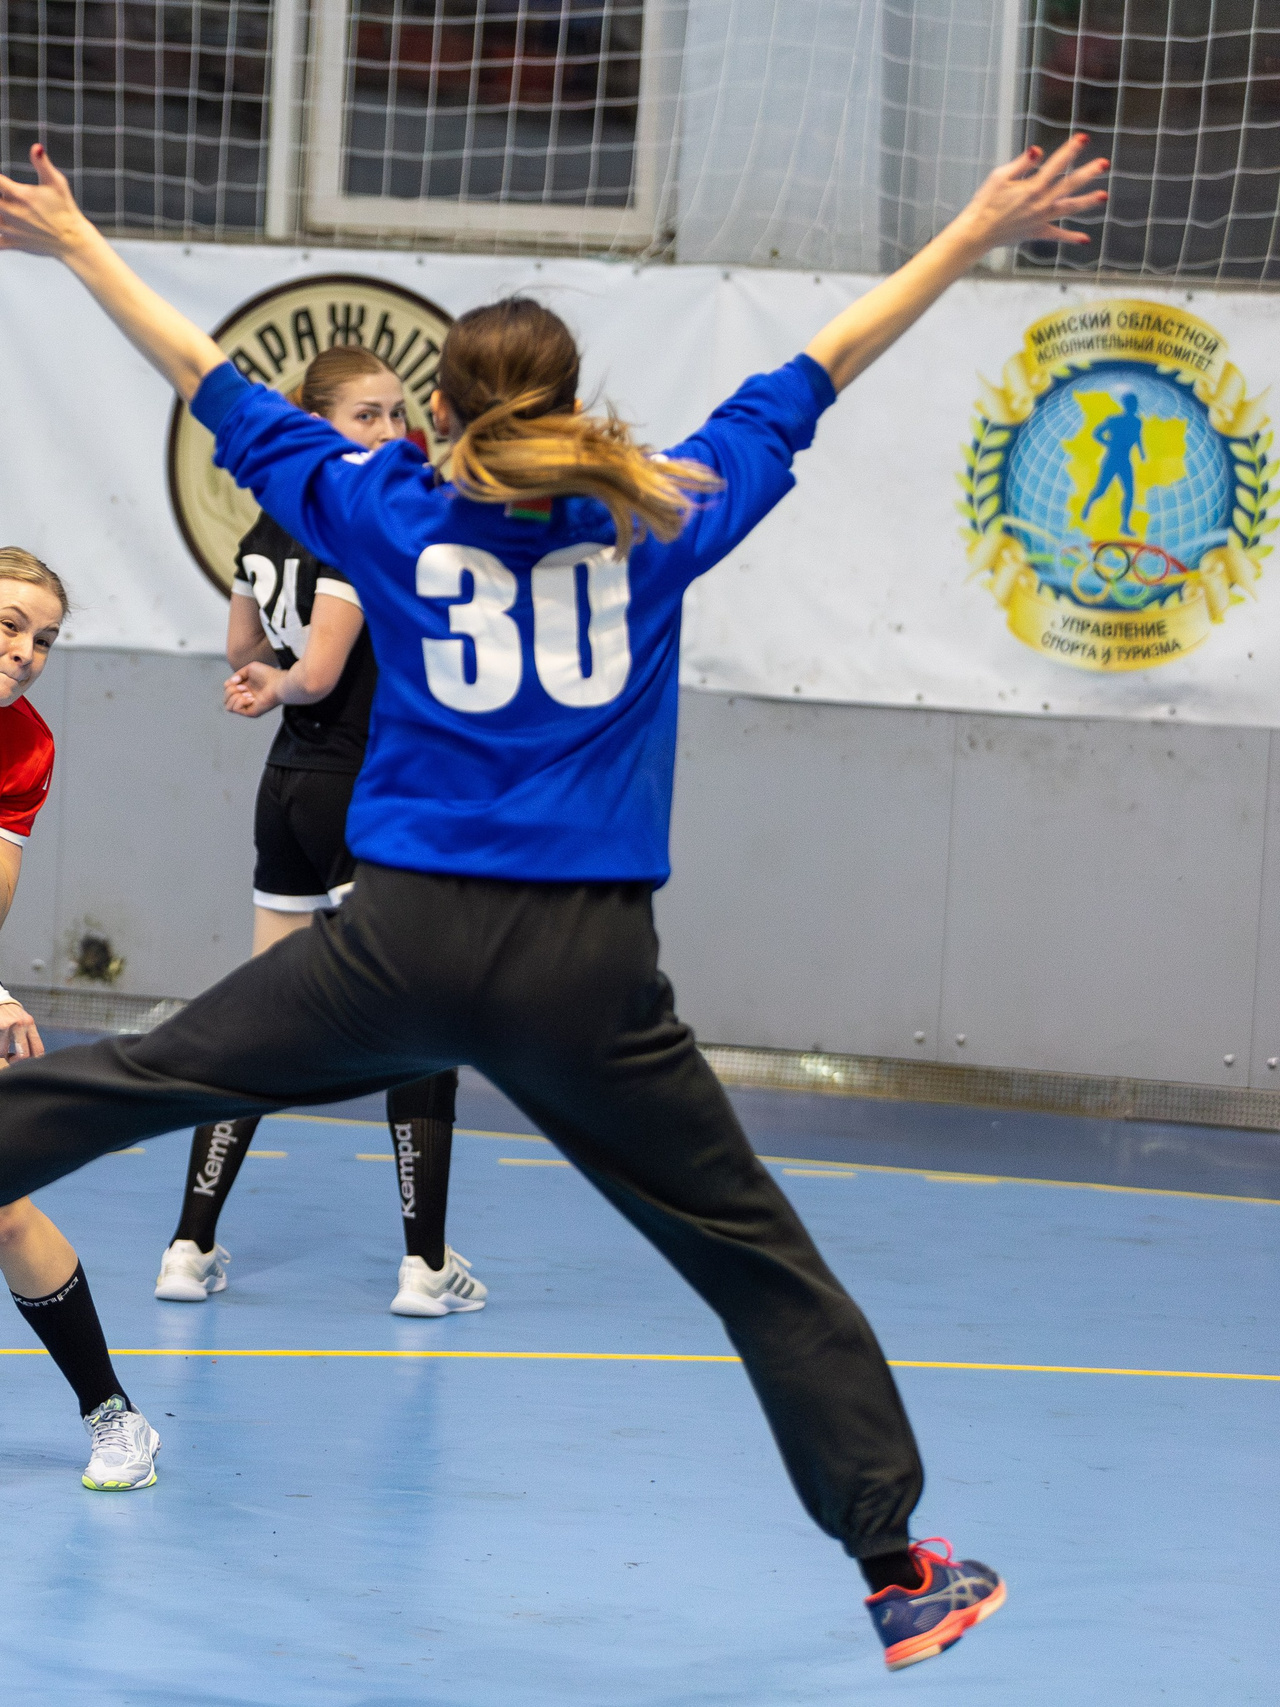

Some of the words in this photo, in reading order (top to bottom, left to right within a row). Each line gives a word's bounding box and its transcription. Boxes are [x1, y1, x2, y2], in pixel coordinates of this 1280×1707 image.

[1030, 309, 1111, 346] МИНСКИЙ
[1116, 310, 1220, 356] ОБЛАСТНОЙ
[1036, 332, 1155, 365] ИСПОЛНИТЕЛЬНЫЙ
[1156, 340, 1215, 372] КОМИТЕТ
[241, 553, 312, 660] 24
[416, 543, 632, 714] 30
[1061, 614, 1168, 639] УПРАВЛЕНИЕ
[1041, 630, 1097, 660] СПОРТА
[1115, 638, 1182, 661] ТУРИЗМА
[394, 1122, 421, 1220] Kempa
